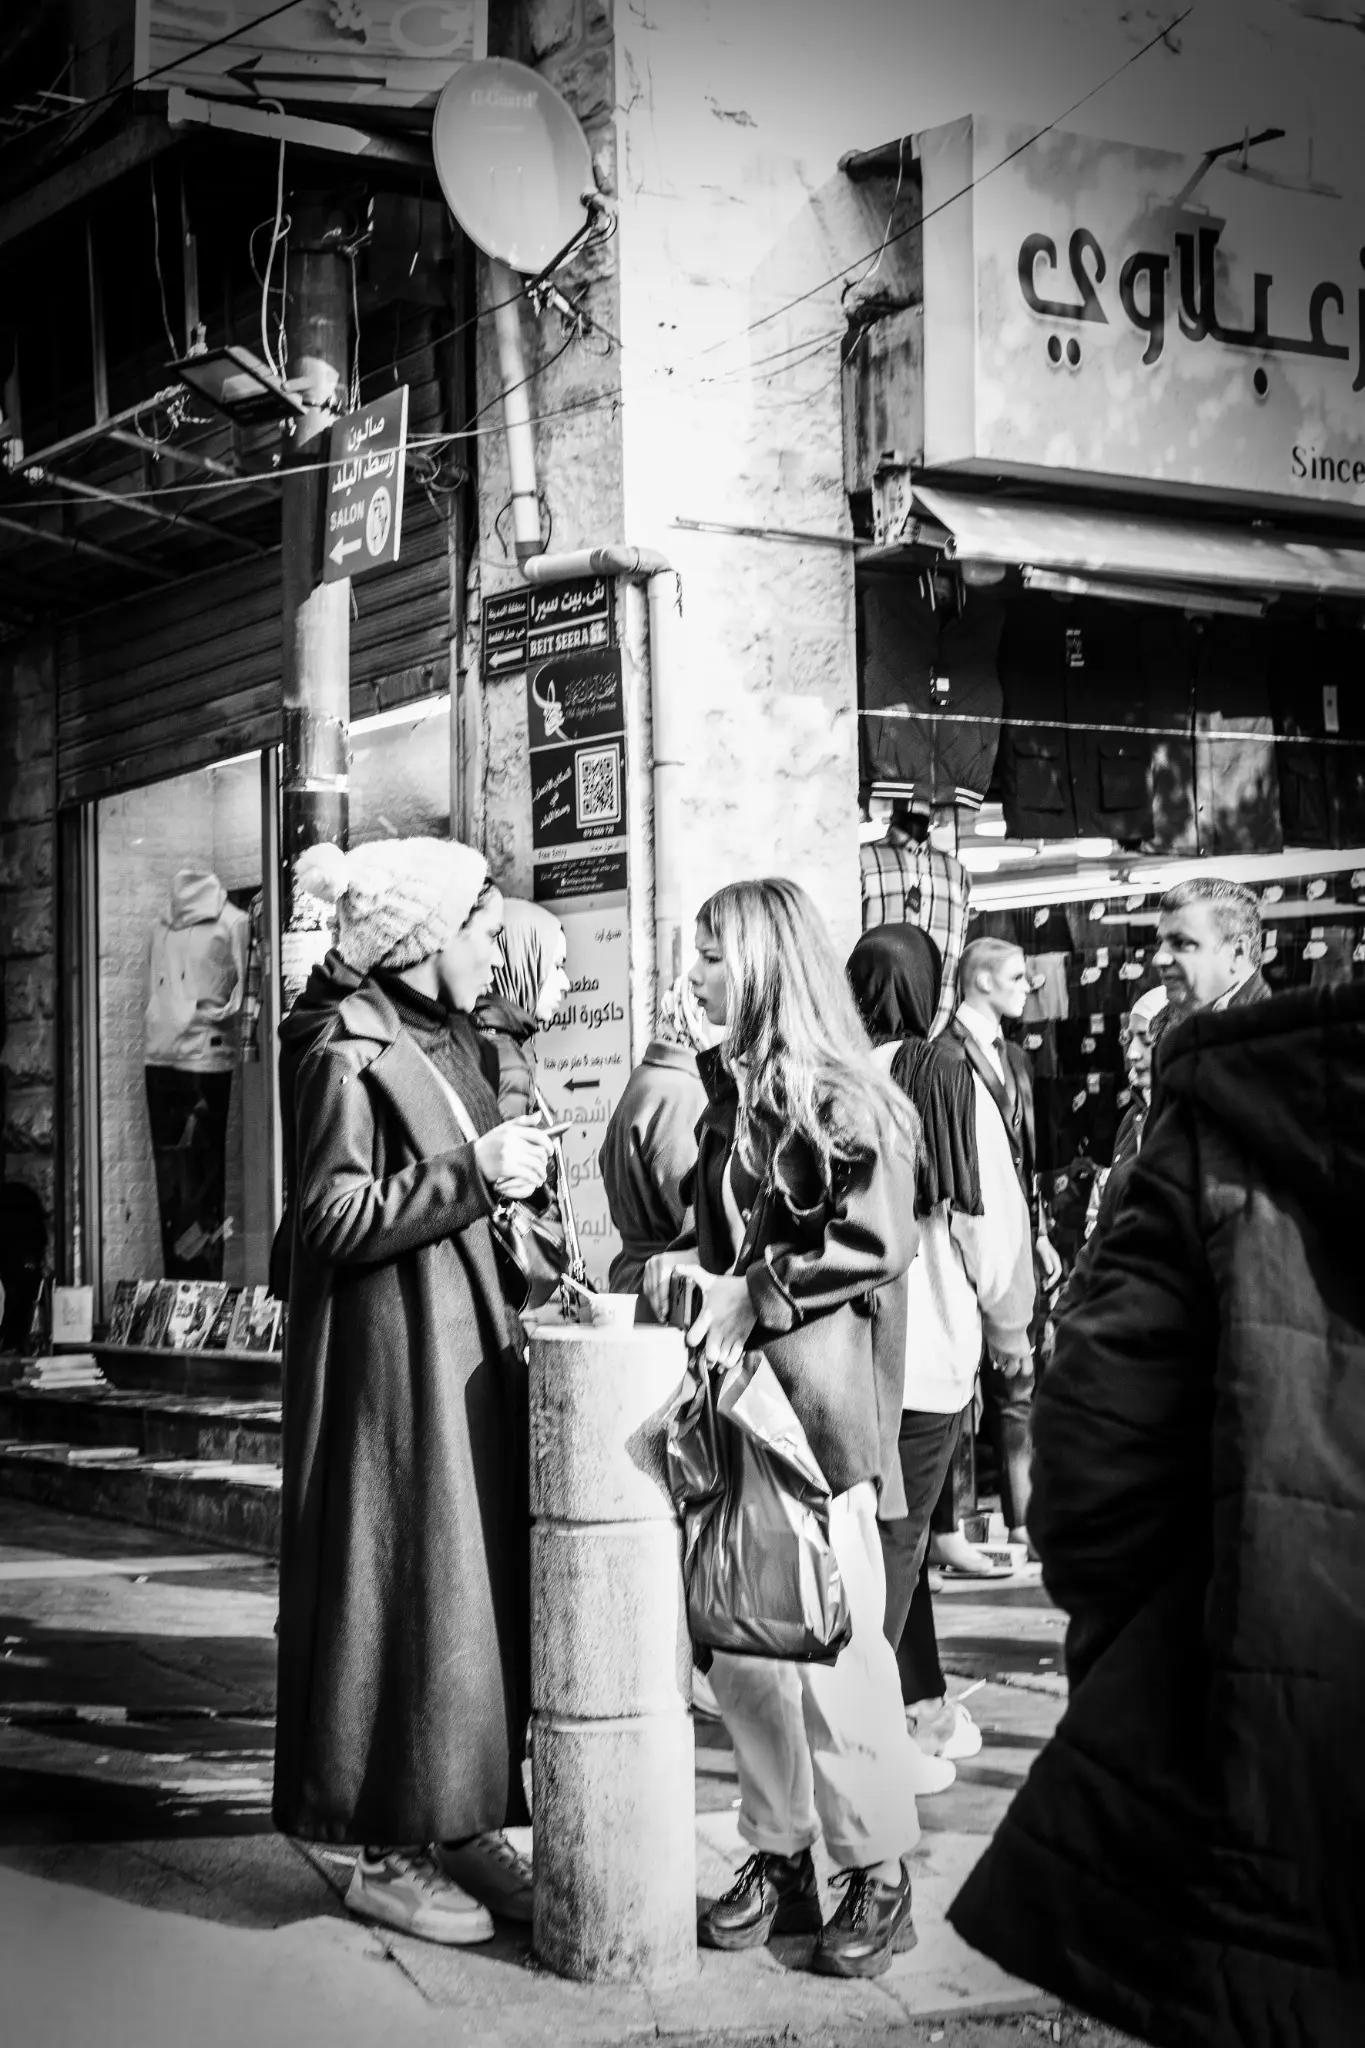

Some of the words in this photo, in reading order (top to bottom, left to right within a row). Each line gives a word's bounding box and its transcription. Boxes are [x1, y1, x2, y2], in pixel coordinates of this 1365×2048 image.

[347, 415, 385, 452] صالون
[331, 459, 362, 497] البلد
[363, 449, 396, 479] وسط
[1292, 445, 1365, 484] Since
[330, 500, 365, 532] SALON
[531, 595, 559, 623] سيرا
[529, 634, 555, 658] BEIT
[555, 627, 589, 652] SEERA
[580, 1002, 624, 1030] حاكورة
